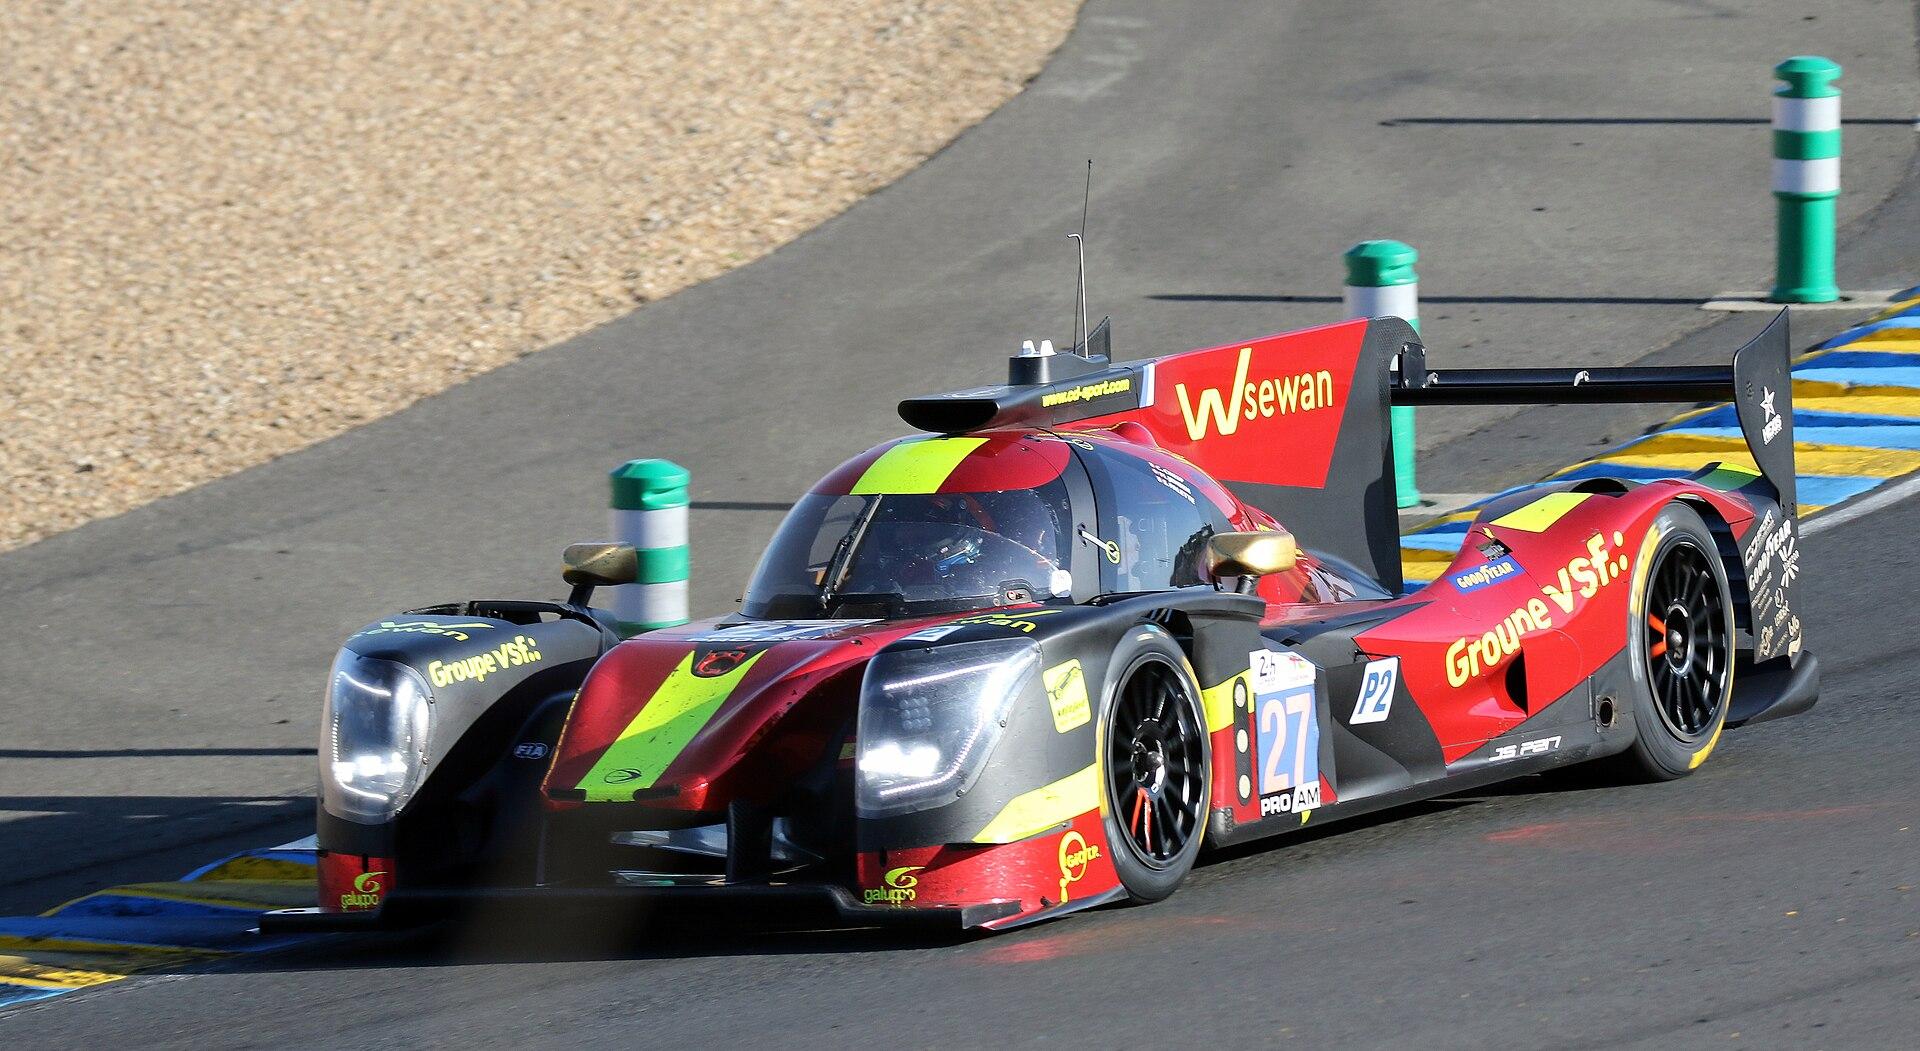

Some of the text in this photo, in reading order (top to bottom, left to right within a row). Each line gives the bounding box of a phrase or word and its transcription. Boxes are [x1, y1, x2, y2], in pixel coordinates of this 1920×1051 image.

[1042, 378, 1130, 408] www.cd-sport.com
[1748, 519, 1792, 591] GOODYEAR
[1457, 561, 1515, 589] GOODYEAR
[428, 653, 497, 688] Groupe
[1358, 670, 1392, 715] P2
[1261, 692, 1311, 793] 27
[1489, 744, 1518, 761] JS
[1260, 787, 1319, 817] PRO AM
[864, 885, 917, 904] galuppo
